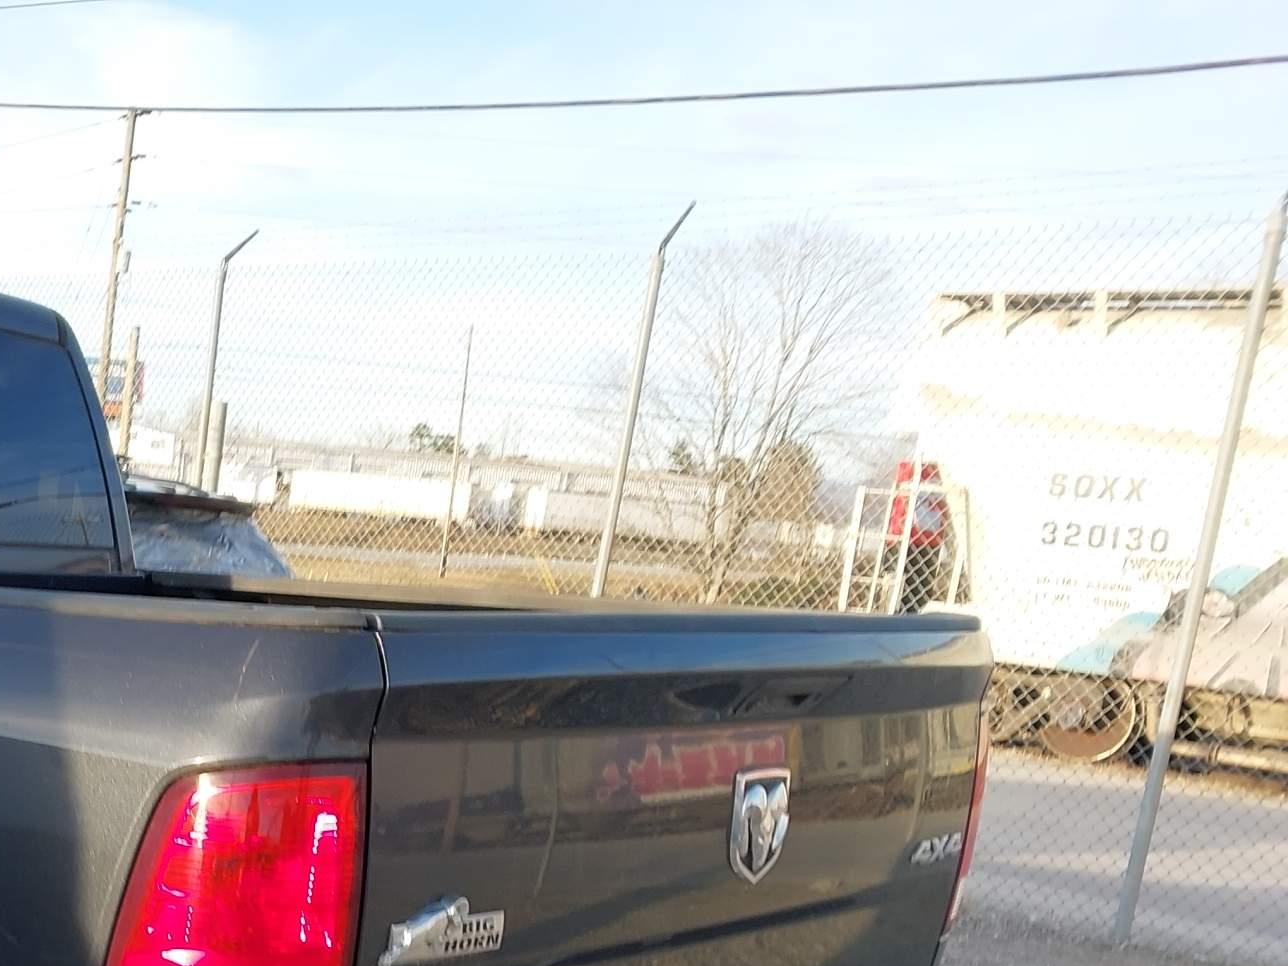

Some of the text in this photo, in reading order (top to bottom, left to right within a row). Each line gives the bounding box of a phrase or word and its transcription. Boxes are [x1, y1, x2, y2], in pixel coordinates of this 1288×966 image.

[1041, 520, 1169, 553] 320130
[462, 917, 495, 933] BIG
[445, 933, 500, 953] HORN
